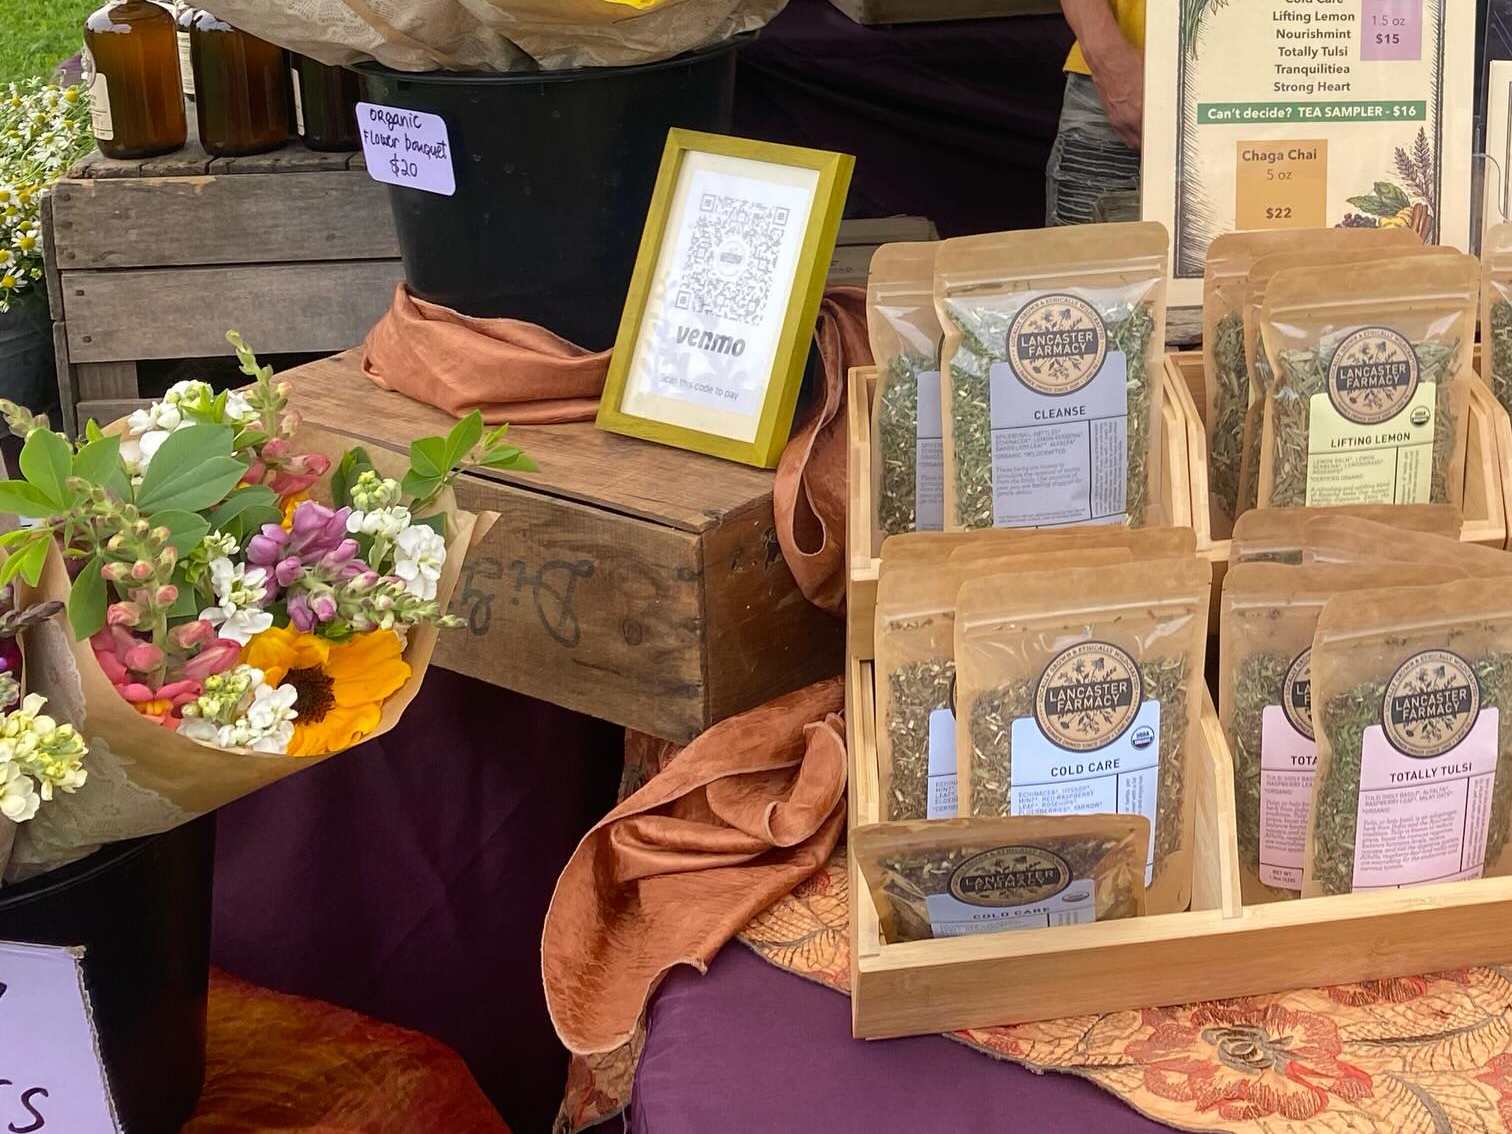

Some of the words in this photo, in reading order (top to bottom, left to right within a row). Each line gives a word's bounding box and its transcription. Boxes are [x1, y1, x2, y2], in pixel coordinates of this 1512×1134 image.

[1272, 11, 1312, 25] Lifting
[1314, 11, 1355, 22] Lemon
[1392, 17, 1406, 26] oz
[1275, 28, 1352, 40] Nourishmint
[1375, 33, 1400, 45] $15
[1278, 46, 1319, 59] Totally
[1321, 46, 1349, 58] Tulsi
[1273, 81, 1315, 95] Strong
[1316, 81, 1351, 93] Heart
[1207, 107, 1241, 120] Can't
[1243, 106, 1293, 119] decide?
[1298, 106, 1323, 118] TEA
[1325, 105, 1383, 117] SAMPLER
[1392, 105, 1417, 118] $16
[404, 133, 448, 160] bouquet
[1241, 149, 1285, 164] Chaga
[1287, 148, 1318, 162] Chai
[389, 152, 418, 177] $20
[1277, 171, 1293, 180] oz
[1265, 207, 1292, 219] $22
[675, 324, 746, 358] venmo
[1021, 331, 1093, 347] LANCASTER
[1028, 342, 1087, 357] FARMACY
[1340, 363, 1406, 380] LANCASTER
[679, 375, 694, 389] this
[694, 380, 714, 396] code
[724, 389, 739, 402] pay
[1346, 375, 1400, 389] FARMACY
[1034, 405, 1086, 420] CLEANSE
[1331, 435, 1371, 448] LIFTING
[1375, 432, 1411, 444] LEMON
[1050, 681, 1128, 702] LANCASTER
[1395, 688, 1467, 711] LANCASTER
[1057, 694, 1120, 712] FARMACY
[1402, 700, 1460, 721] FARMACY
[1051, 764, 1084, 777] COLD
[1088, 758, 1120, 773] CARE
[1390, 767, 1437, 783] TOTALLY
[1440, 762, 1472, 775] TULSI
[965, 870, 1055, 886] LANCASTER
[973, 912, 1009, 920] COLD
[1014, 907, 1051, 915] CARE
